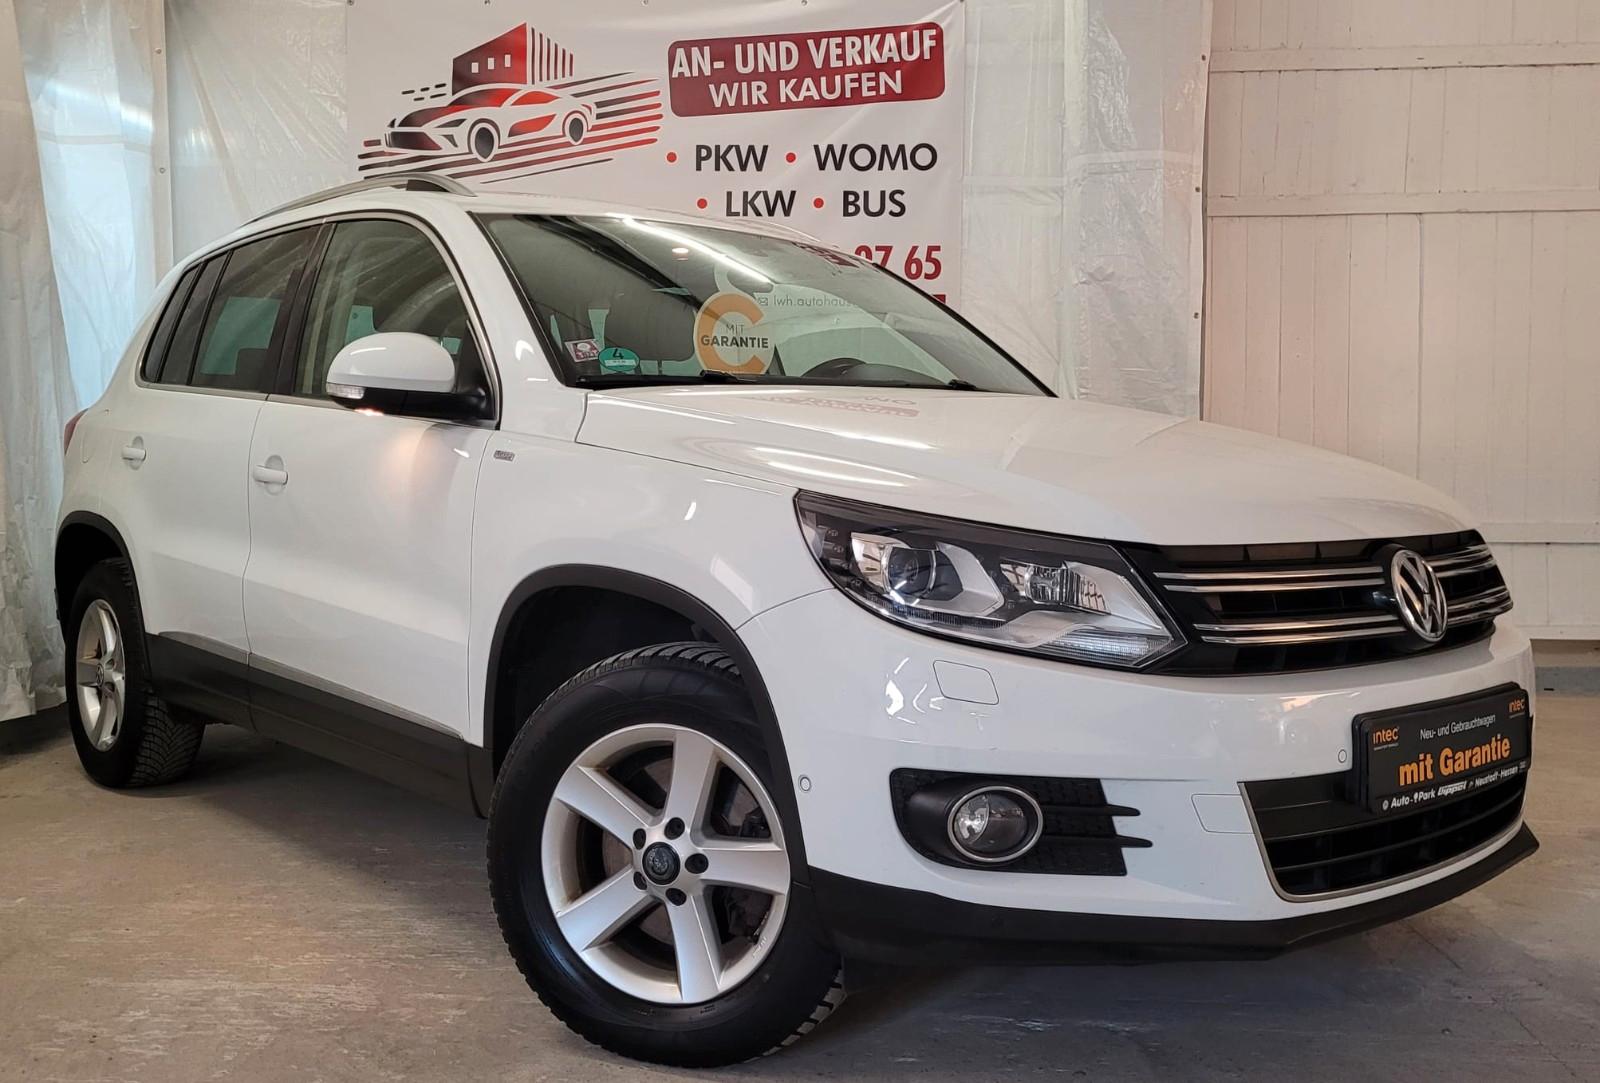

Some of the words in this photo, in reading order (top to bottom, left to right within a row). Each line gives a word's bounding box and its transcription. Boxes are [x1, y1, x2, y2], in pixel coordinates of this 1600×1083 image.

[671, 45, 725, 78] AN-
[734, 40, 799, 74] UND
[807, 29, 937, 69] VERKAUF
[708, 80, 769, 108] WIR
[779, 70, 902, 103] KAUFEN
[695, 144, 769, 172] PKW
[813, 142, 938, 172] WOMO
[725, 190, 797, 217] LKW
[842, 189, 906, 218] BUS
[904, 245, 942, 280] 65
[700, 335, 769, 349] GARANTIE
[725, 323, 745, 332] MIT
[612, 347, 625, 360] 4
[1372, 728, 1399, 744] intec
[1420, 728, 1437, 740] Neu-
[1437, 723, 1450, 737] und
[1450, 714, 1496, 734] Gebrauchtwagen
[1398, 753, 1433, 786] mit
[1439, 734, 1511, 776] Garantie
